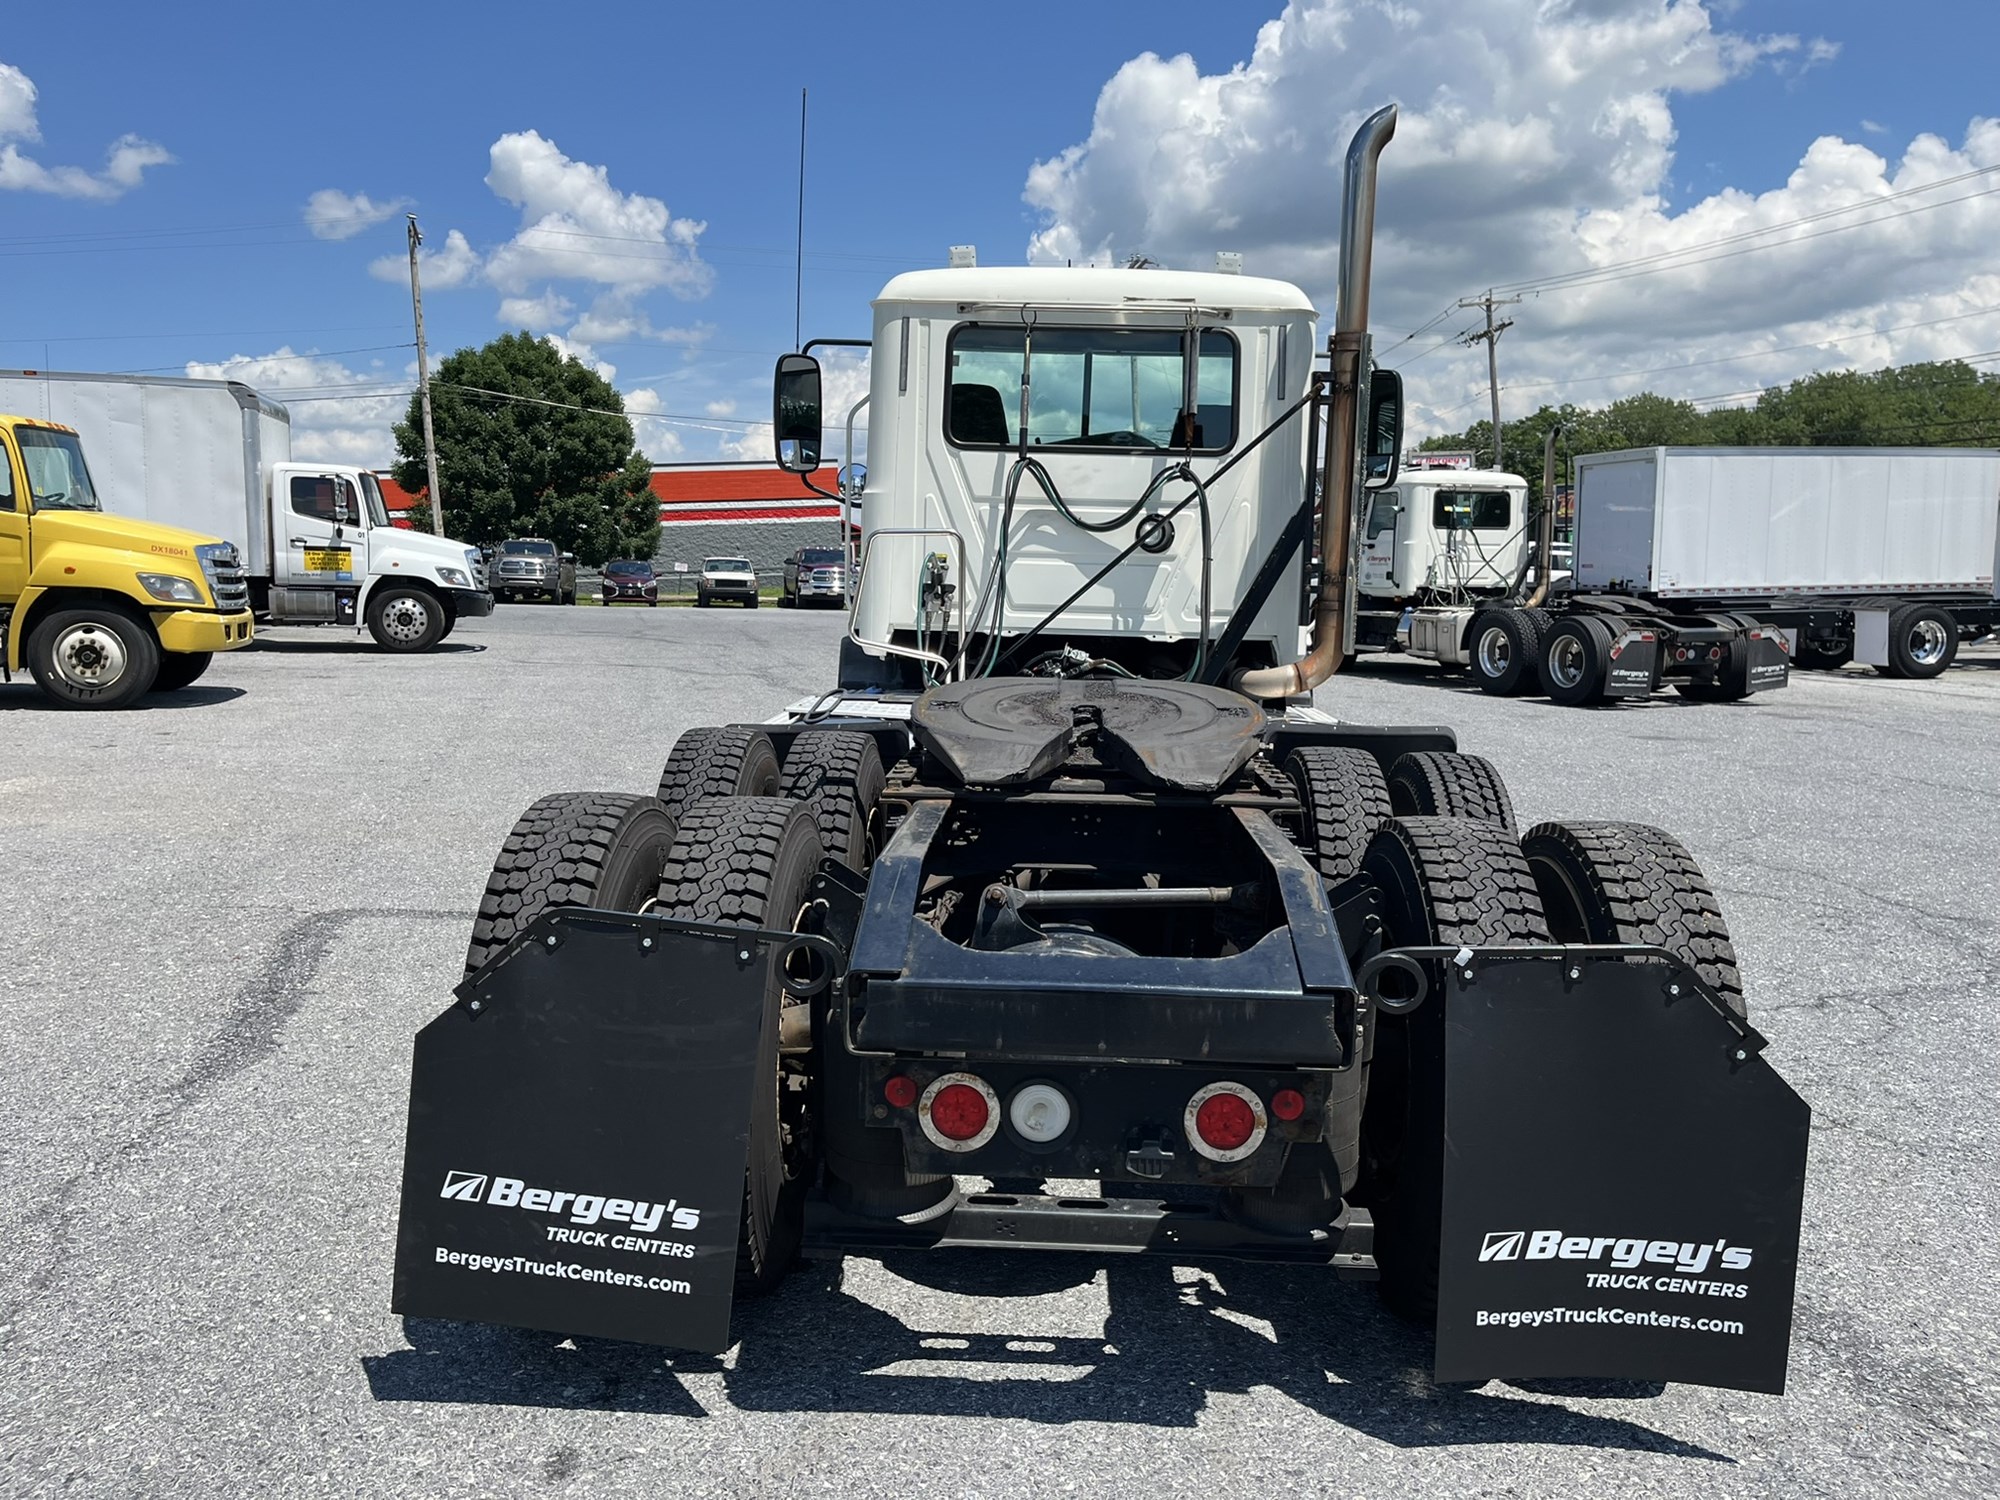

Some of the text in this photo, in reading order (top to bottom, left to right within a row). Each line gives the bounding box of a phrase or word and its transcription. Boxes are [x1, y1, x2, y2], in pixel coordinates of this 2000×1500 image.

[151, 545, 188, 556] DX18041
[487, 1176, 701, 1232] Bergey's
[546, 1226, 696, 1259] TRUCK CENTERS
[1524, 1230, 1753, 1274] Bergey's
[434, 1246, 692, 1295] BergeysTruckCenters.com
[1586, 1273, 1749, 1299] TRUCK CENTERS
[1475, 1307, 1745, 1335] BergeysTruckCenters.com
